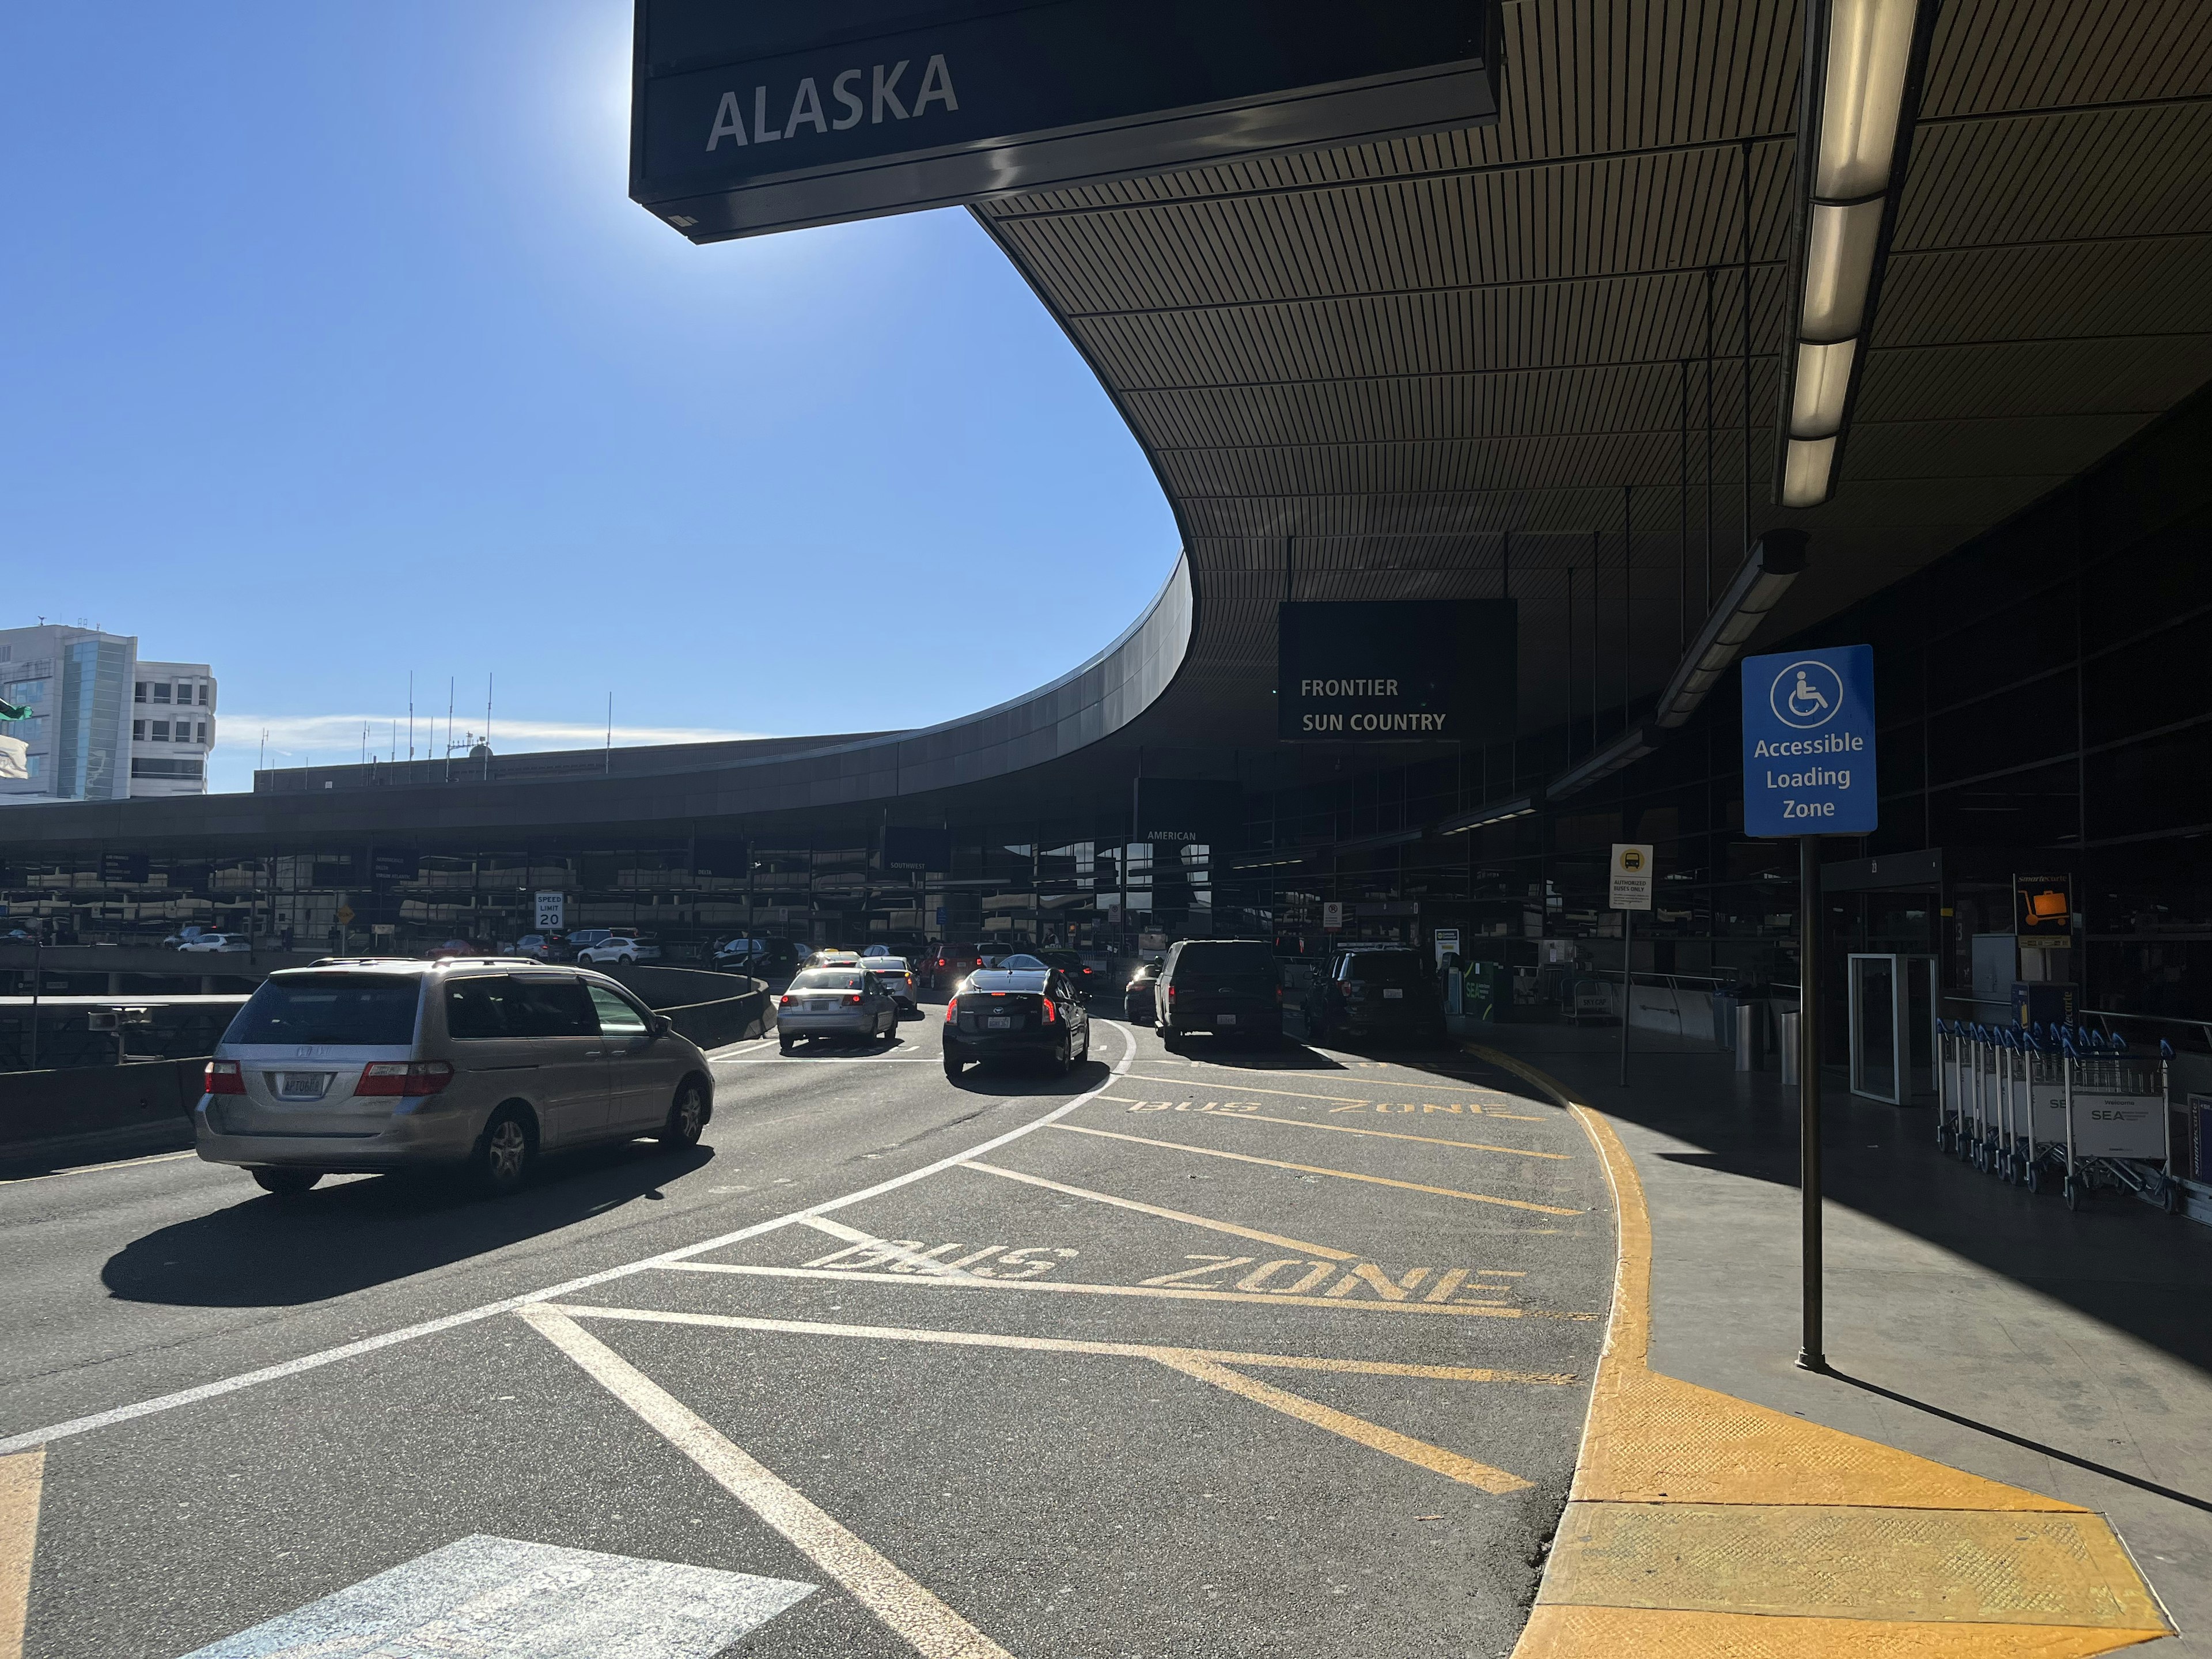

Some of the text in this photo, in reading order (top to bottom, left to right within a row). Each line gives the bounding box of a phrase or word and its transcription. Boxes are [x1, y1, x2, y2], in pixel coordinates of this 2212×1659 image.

[706, 54, 959, 151] ALASKA
[1301, 679, 1399, 696] FRONTIER
[1302, 713, 1446, 731] SUN COUNTRY
[1753, 732, 1863, 758] Accessible
[1767, 767, 1851, 790] Loading
[1783, 800, 1835, 819] Zone
[1147, 831, 1196, 841] AMERICAN
[890, 862, 926, 870] SOUTHWEST
[540, 914, 559, 925] 20
[1466, 982, 1480, 999] SEA
[1126, 1101, 1514, 1114] BUS ZONE
[2092, 1111, 2125, 1120] SEA
[801, 1238, 1527, 1305] BUS ZONE
